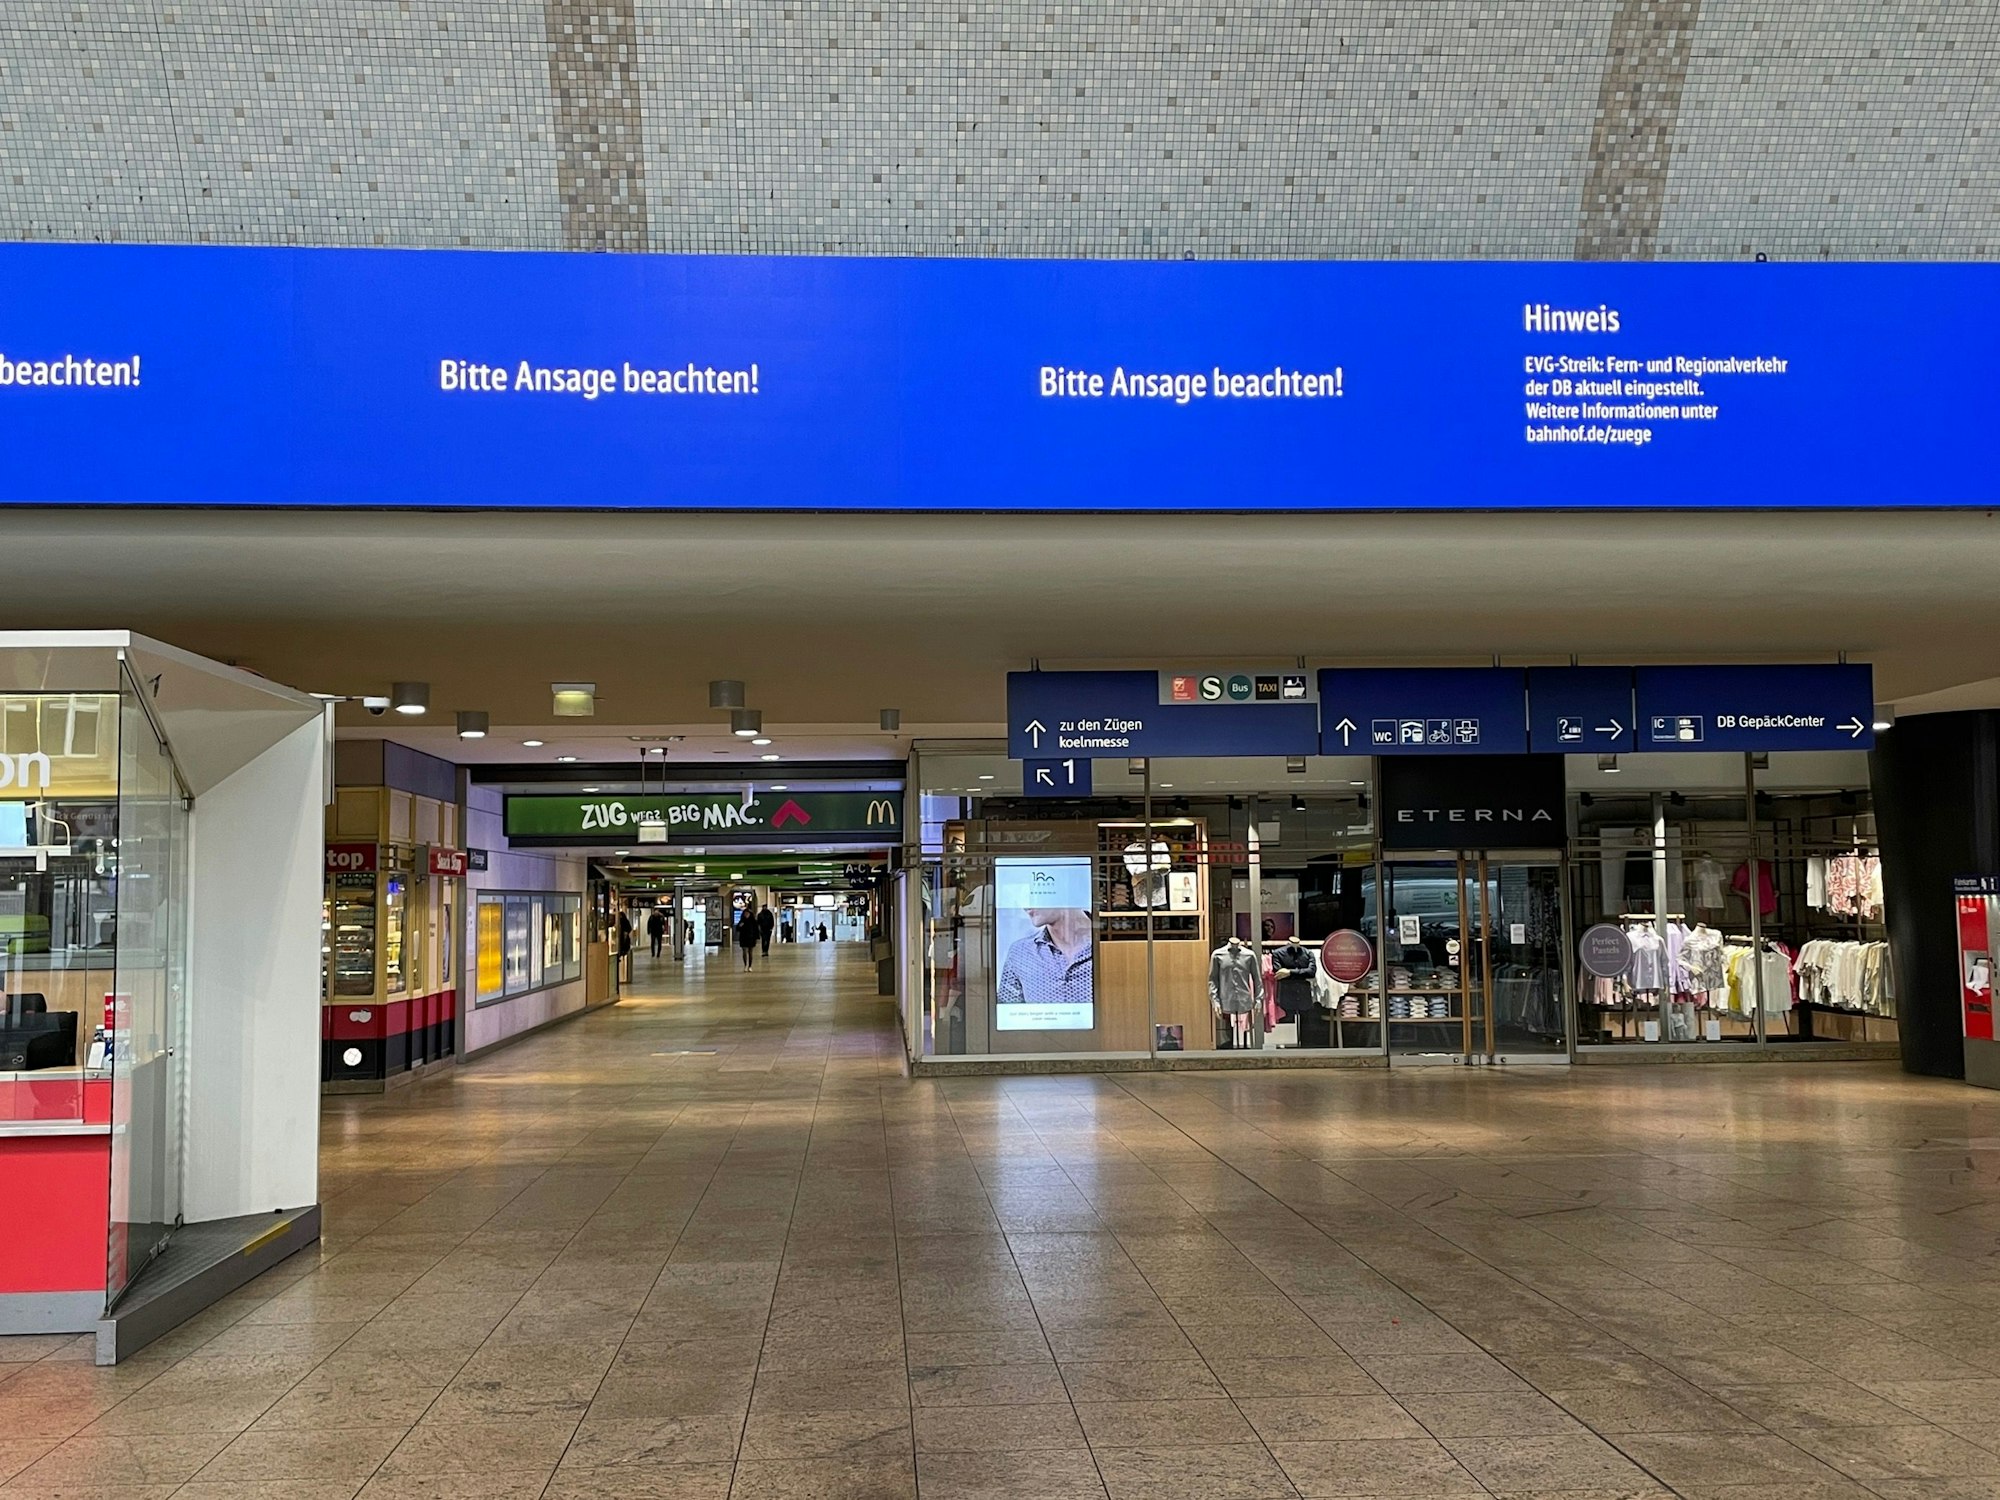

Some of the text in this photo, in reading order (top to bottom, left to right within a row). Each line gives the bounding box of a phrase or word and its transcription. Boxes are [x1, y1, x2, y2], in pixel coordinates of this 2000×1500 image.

[1525, 304, 1619, 333] Hinweis
[0, 354, 140, 387] beachten!
[1525, 356, 1788, 377] EVG-Streik: Fern- und Regionalverkehr
[440, 360, 758, 400] Bitte Ansage beachten!
[1040, 367, 1343, 404] Bitte Ansage beachten!
[1526, 379, 1705, 399] der DB aktuell eingestellt.
[1526, 402, 1718, 419] Weitere Informationen unter
[1526, 425, 1652, 446] bahnhof.de/zuege
[1202, 677, 1221, 700] S
[1232, 683, 1249, 692] Bus
[1257, 683, 1277, 692] TAXI
[1059, 717, 1143, 734] zu den Zügen
[1441, 721, 1448, 729] P
[1654, 718, 1665, 729] IC
[1717, 714, 1825, 730] DB GepäckCenter
[1059, 735, 1130, 749] koelnmesse
[1374, 732, 1392, 742] WC
[1402, 728, 1412, 743] P
[0, 752, 51, 788] on
[1063, 760, 1076, 784] 1
[581, 802, 628, 830] ZUG
[1397, 809, 1552, 823] ETERNA
[1591, 937, 1620, 945] Perfect
[1592, 946, 1620, 954] Pastels
